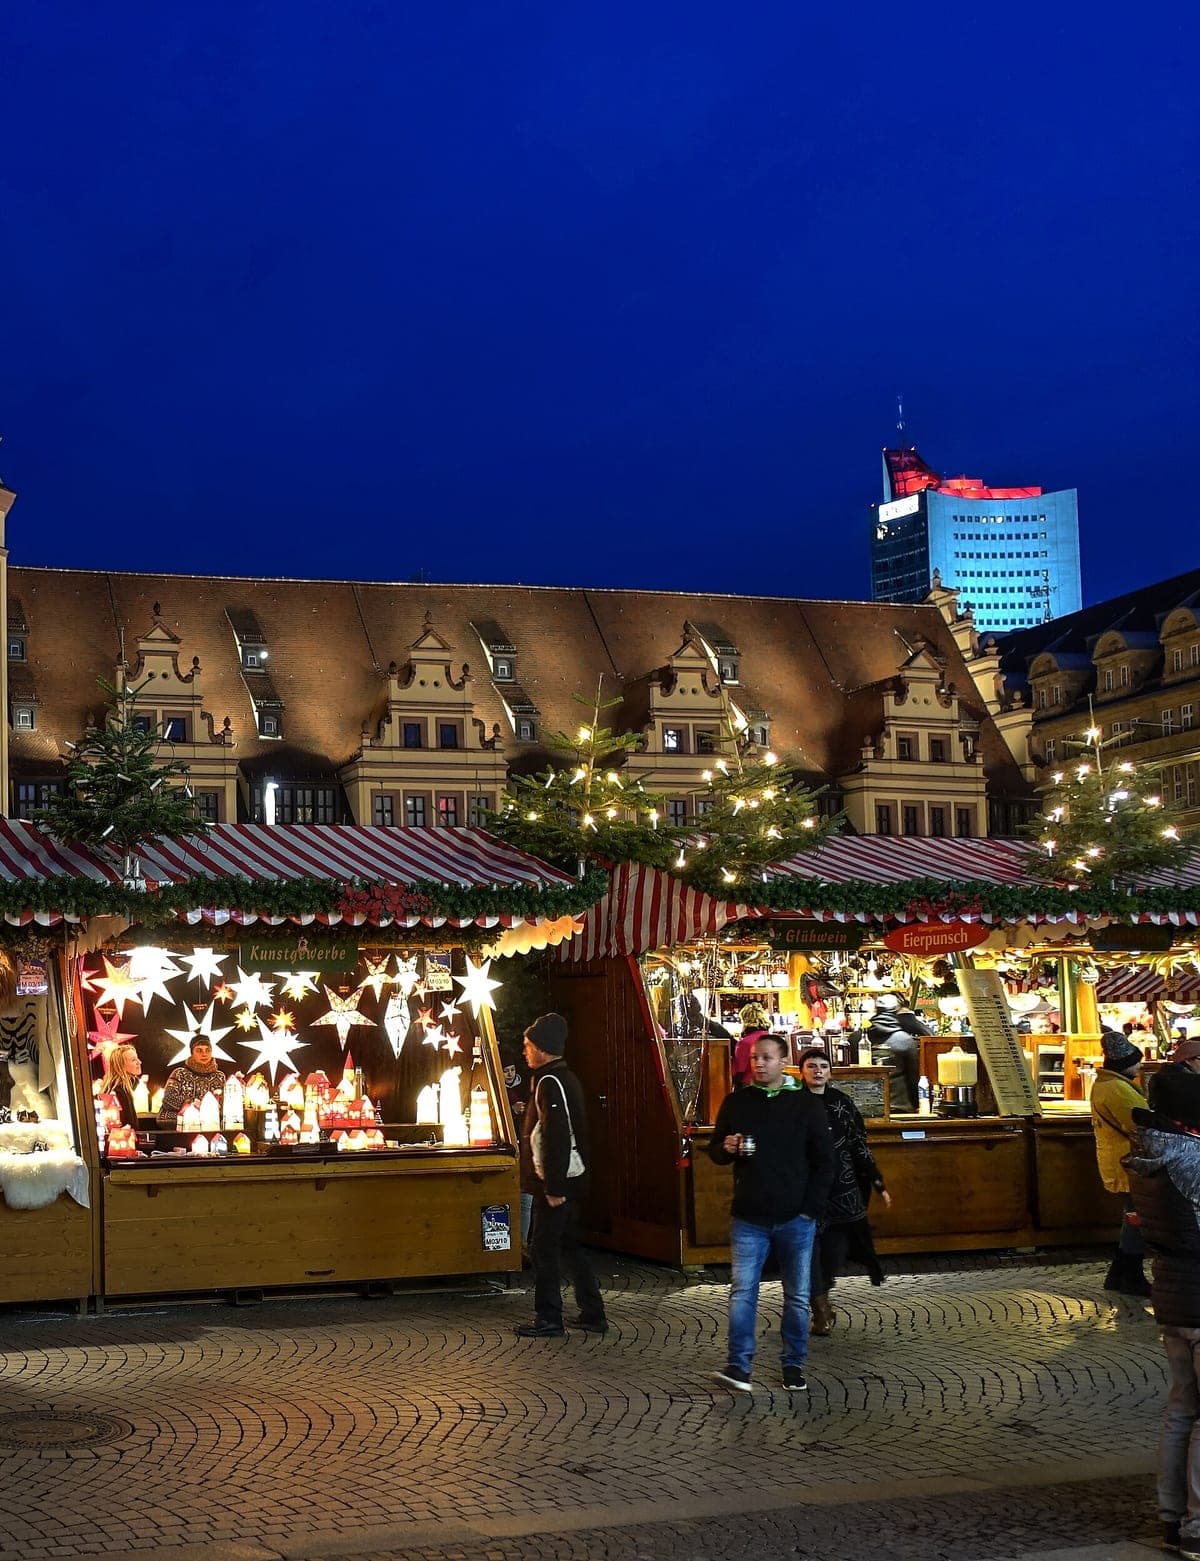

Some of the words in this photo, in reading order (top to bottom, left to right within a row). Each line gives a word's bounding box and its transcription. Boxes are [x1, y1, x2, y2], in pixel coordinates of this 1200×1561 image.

[785, 929, 848, 943] Glühwein
[903, 927, 968, 951] Eierpunsch
[250, 944, 347, 965] Kunstgewerbe
